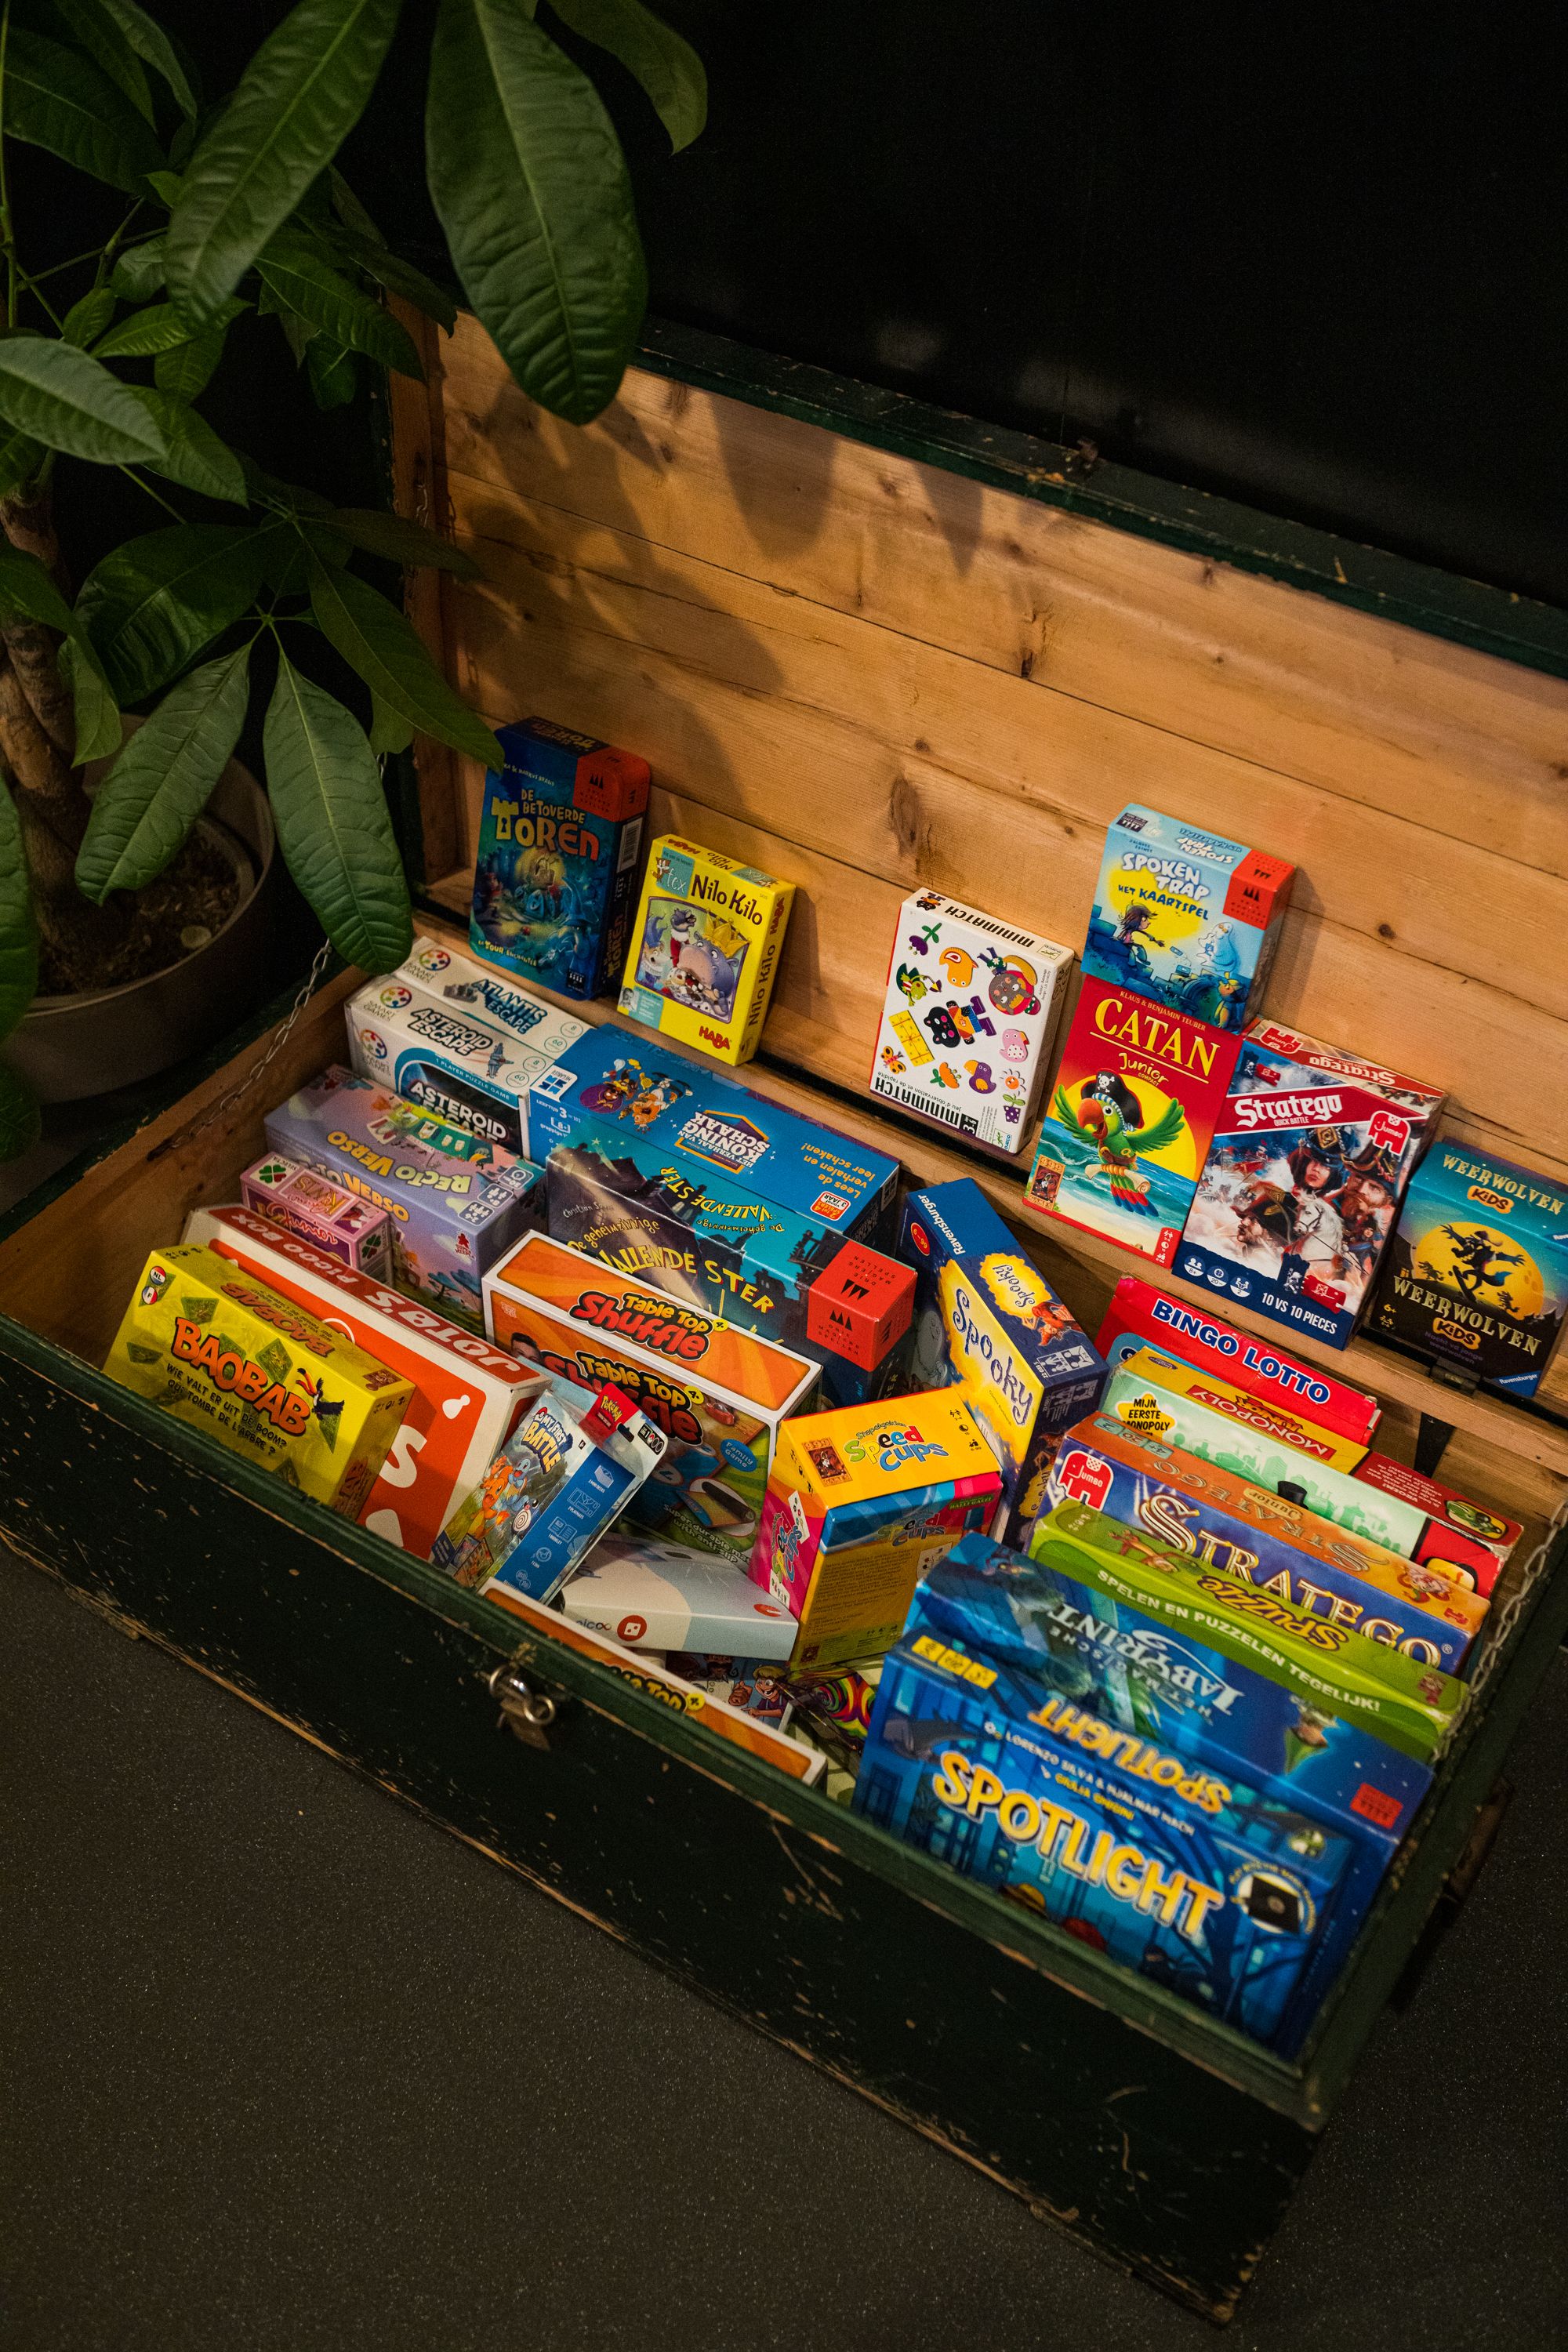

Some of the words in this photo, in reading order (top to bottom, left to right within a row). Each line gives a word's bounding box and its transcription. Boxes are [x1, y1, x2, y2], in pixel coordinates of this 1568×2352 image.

[521, 789, 534, 802] DE
[522, 799, 585, 825] BETOVERDE
[491, 797, 599, 860] TOREN
[668, 837, 700, 856] HABA
[706, 851, 728, 865] Kilo
[1176, 837, 1203, 851] TRAP
[1179, 844, 1233, 865] SPOKEN
[710, 862, 735, 872] Nilo
[1122, 853, 1200, 884] SPOKEN
[691, 873, 727, 907] Nilo
[729, 889, 763, 925] Kilo
[1118, 885, 1136, 897] HET
[1139, 888, 1209, 920] KAARTSPEL
[1154, 875, 1210, 902] TRAP
[770, 897, 785, 935] HABA
[484, 941, 504, 955] TOUR
[748, 985, 765, 1027] Nilo
[759, 944, 775, 984] Kilo
[471, 979, 547, 1023] ATLANTIS
[1120, 991, 1140, 1004] KLAUS
[1147, 1003, 1181, 1020] BENJAMIN
[1181, 1014, 1206, 1031] TEUBER
[411, 1008, 492, 1050] ASTEROID
[488, 1001, 532, 1033] ESCAPE
[408, 1020, 477, 1055] ESCAPE
[699, 1025, 731, 1050] HABA
[1095, 998, 1221, 1077] CATAN
[1268, 1033, 1298, 1049] Jumbo
[441, 1062, 464, 1075] PLAYER
[466, 1073, 490, 1087] PUZZLE
[491, 1087, 510, 1100] GAME
[877, 1071, 898, 1083] rapidité
[1119, 1052, 1169, 1085] Junior
[1138, 1073, 1159, 1087] COMPACT
[1309, 1057, 1396, 1085] Stratego
[410, 1082, 506, 1138] ASTEROID
[559, 1106, 567, 1117] 3
[914, 1087, 950, 1109] d'observation
[1235, 1094, 1342, 1127] Stratego
[540, 1123, 563, 1136] grappige
[677, 1130, 696, 1142] VAN
[688, 1112, 772, 1155] SCHAAK
[1274, 1118, 1288, 1127] QUICK
[1290, 1116, 1308, 1126] BATTLE
[1373, 1120, 1403, 1140] Jumbo
[327, 1131, 394, 1175] VERSO
[680, 1120, 764, 1164] KONING
[695, 1138, 738, 1161] VERHAAL
[800, 1142, 852, 1171] schaken!
[735, 1156, 754, 1169] HET
[803, 1155, 818, 1167] en
[817, 1161, 869, 1190] verhalen
[853, 1166, 876, 1181] leer
[1040, 1156, 1065, 1171] 999
[395, 1166, 470, 1194] RECTO
[660, 1167, 698, 1201] STER
[817, 1174, 832, 1187] de
[830, 1180, 862, 1200] Lees
[1443, 1154, 1566, 1215] WEERWOLVEN
[342, 1171, 410, 1221] VERSO
[563, 1203, 596, 1218] Christian
[693, 1190, 770, 1223] VALLENDE
[818, 1201, 841, 1214] SPELERS
[824, 1195, 840, 1203] JAAR
[1029, 1195, 1052, 1210] GAMES
[234, 1214, 279, 1243] BOX
[583, 1217, 659, 1243] geheimzinnige
[697, 1218, 767, 1235] geheimzinnige
[771, 1223, 785, 1234] De
[919, 1194, 966, 1254] Ravensburger
[282, 1242, 359, 1283] PICOO
[846, 1261, 893, 1285] MAGIERS
[854, 1255, 896, 1278] SPELLEN
[597, 1243, 696, 1276] VALLENDE
[704, 1260, 775, 1314] STER
[852, 1272, 877, 1286] DRIE
[993, 1265, 1035, 1308] Spooky
[221, 1283, 335, 1357] BAOBAB
[624, 1293, 674, 1317] Table
[677, 1308, 713, 1333] Top
[1262, 1293, 1274, 1305] 10
[1276, 1298, 1287, 1312] VS
[1290, 1305, 1302, 1318] 10
[1304, 1311, 1337, 1334] PIECES
[1384, 1304, 1396, 1314] 6+
[1393, 1276, 1541, 1356] WEERWOLVEN
[571, 1293, 709, 1359] Shuffle
[818, 1326, 860, 1350] MAGIERS
[827, 1323, 851, 1338] DRIE
[818, 1331, 858, 1355] SPELLEN
[1151, 1299, 1240, 1356] BINGO
[1243, 1346, 1330, 1403] LOTTO
[953, 1289, 1033, 1427] Spooky
[172, 1318, 310, 1436] BAOBAB
[582, 1356, 641, 1388] Table
[644, 1377, 685, 1408] Top
[1499, 1374, 1537, 1385] Ravensburger
[187, 1375, 208, 1395] VALT
[210, 1390, 221, 1403] ER
[242, 1414, 254, 1428] DE
[256, 1422, 287, 1448] BOOM?
[1128, 1410, 1161, 1421] EERSTE
[1134, 1398, 1156, 1410] MIJN
[187, 1392, 215, 1417] TOMBE
[218, 1412, 230, 1425] DE
[232, 1421, 265, 1450] L'ARBRE
[542, 1414, 555, 1429] MY
[554, 1419, 567, 1446] FIRST
[1192, 1391, 1329, 1457] MONOPOLY
[522, 1422, 561, 1472] BATTLE
[725, 1441, 753, 1463] Family
[804, 1436, 832, 1450] 999
[844, 1426, 924, 1465] Speed
[879, 1443, 949, 1472] Cups
[729, 1451, 748, 1467] Game
[1249, 1490, 1298, 1521] Junior
[1382, 1483, 1417, 1502] VROEM!
[877, 1514, 941, 1544] Speed
[1152, 1460, 1389, 1572] STRATEGO
[673, 1517, 695, 1534] with
[697, 1532, 738, 1563] anti-slip
[692, 1518, 729, 1546] durable
[892, 1525, 946, 1547] Cups
[772, 1512, 792, 1582] Speed
[785, 1524, 803, 1582] Cups
[1097, 1570, 1162, 1608] SPELEN
[1164, 1603, 1190, 1618] EN
[1193, 1612, 1285, 1665] PUZZELEN
[1287, 1661, 1380, 1712] TEGELIJK!
[1047, 1602, 1247, 1715] LABYRINT
[1049, 1624, 1163, 1691] MAGISCHE
[1168, 1688, 1213, 1721] HET
[1005, 1732, 1058, 1765] LORENZO
[1061, 1759, 1094, 1787] SILVA
[1028, 1697, 1232, 1813] SPOTLIGHT
[933, 1750, 1225, 1940] SPOTLIGHT
